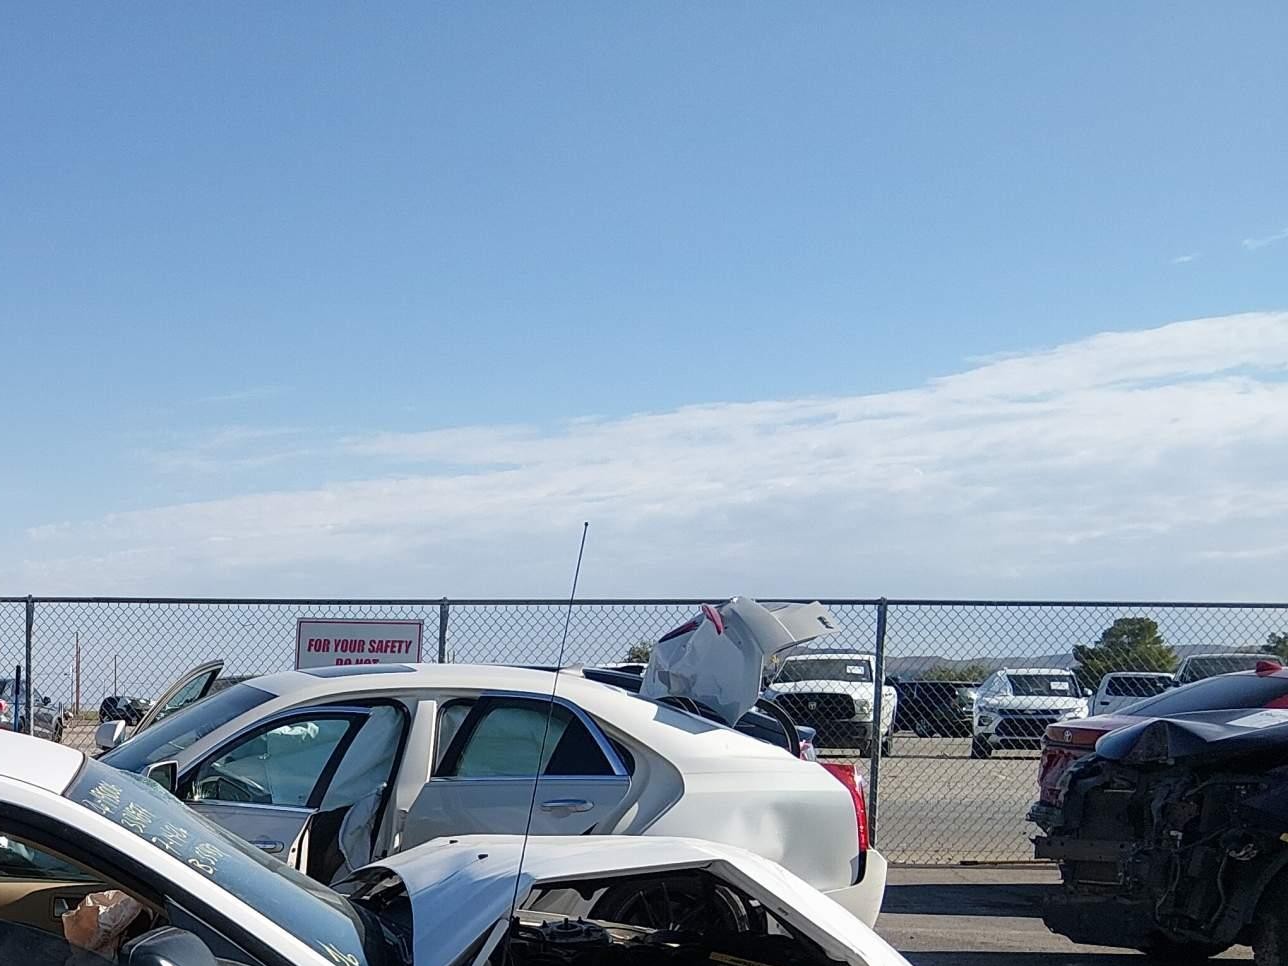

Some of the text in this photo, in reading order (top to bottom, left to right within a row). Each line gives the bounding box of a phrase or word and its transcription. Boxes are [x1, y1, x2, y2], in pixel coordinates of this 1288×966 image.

[307, 638, 412, 654] FOR YOUR SAFETY
